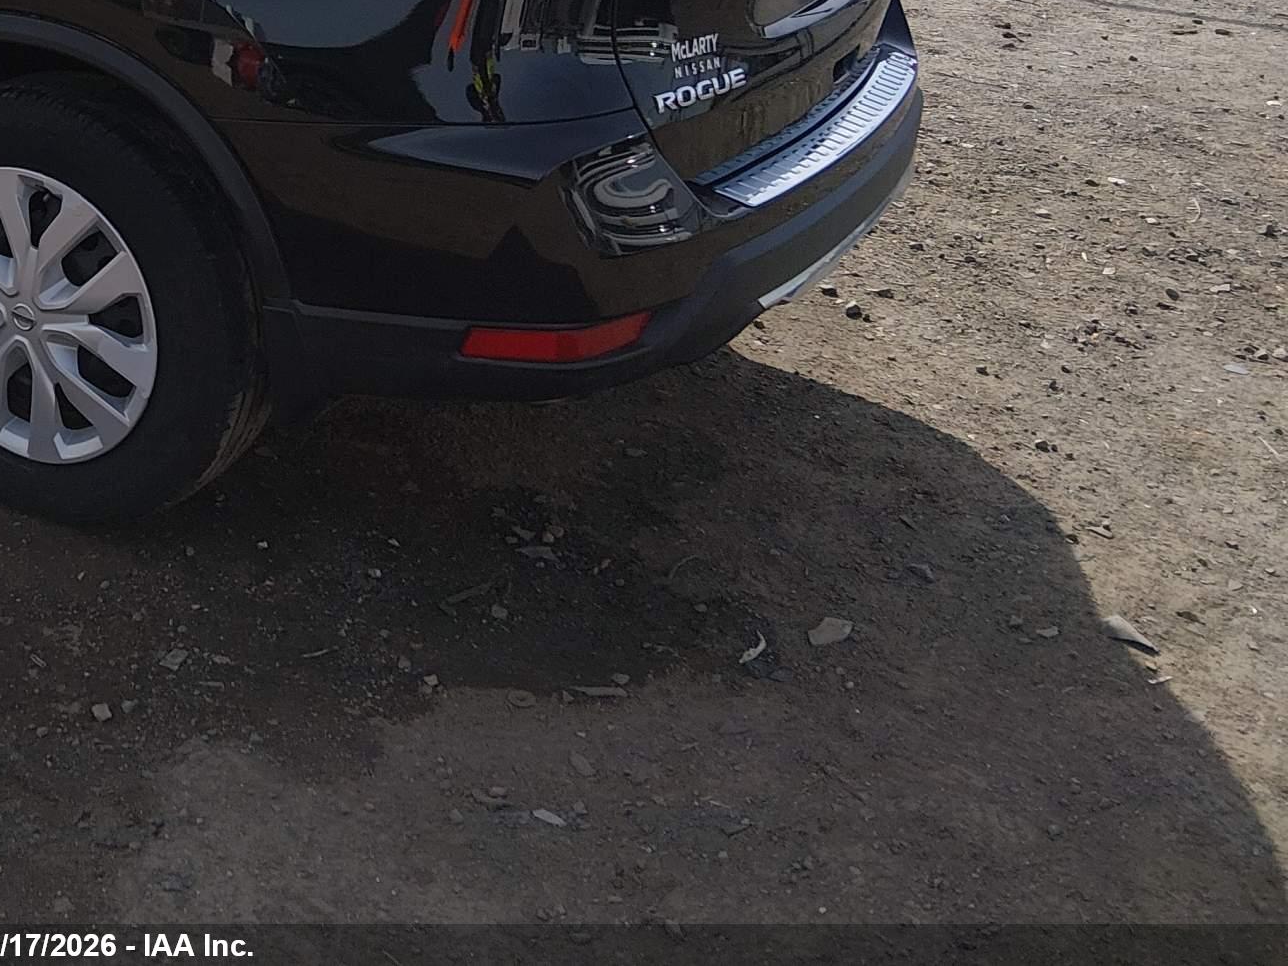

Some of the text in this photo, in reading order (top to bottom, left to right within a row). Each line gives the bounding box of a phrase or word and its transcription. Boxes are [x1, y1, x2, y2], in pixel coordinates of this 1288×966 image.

[671, 33, 719, 62] McLARTY
[674, 57, 721, 79] NISSAN
[654, 68, 747, 114] ROGUE
